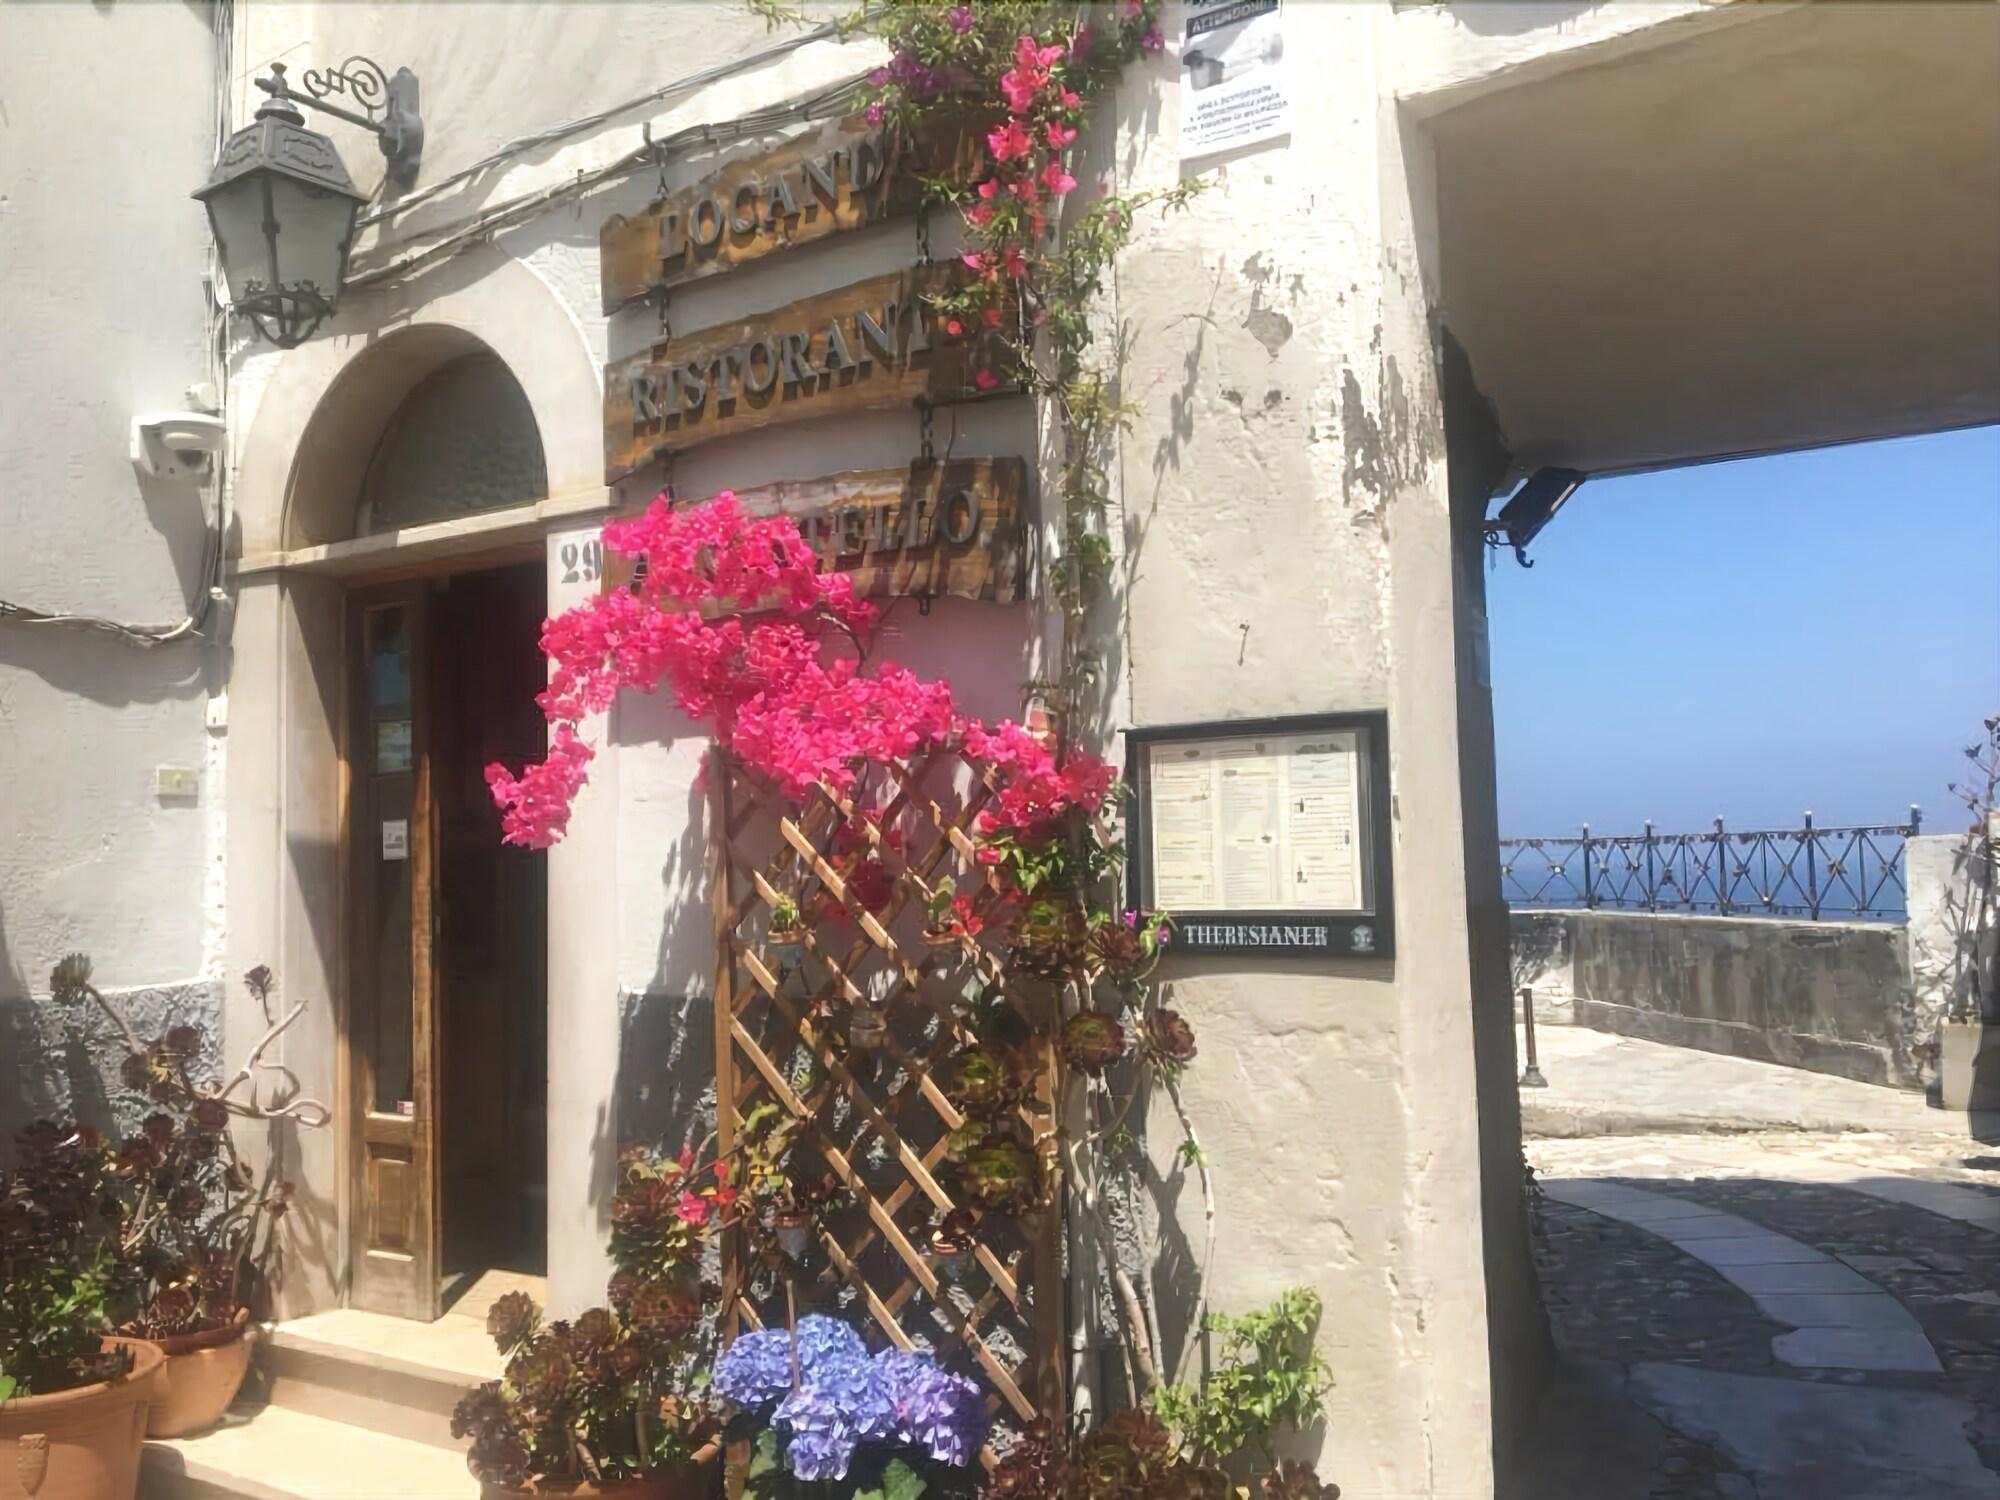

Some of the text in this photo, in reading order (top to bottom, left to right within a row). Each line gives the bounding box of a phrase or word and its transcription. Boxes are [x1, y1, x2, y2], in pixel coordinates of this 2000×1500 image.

[660, 130, 918, 260] LOCAND
[630, 302, 944, 426] RISTORANT
[1183, 924, 1329, 946] THERESIANER
